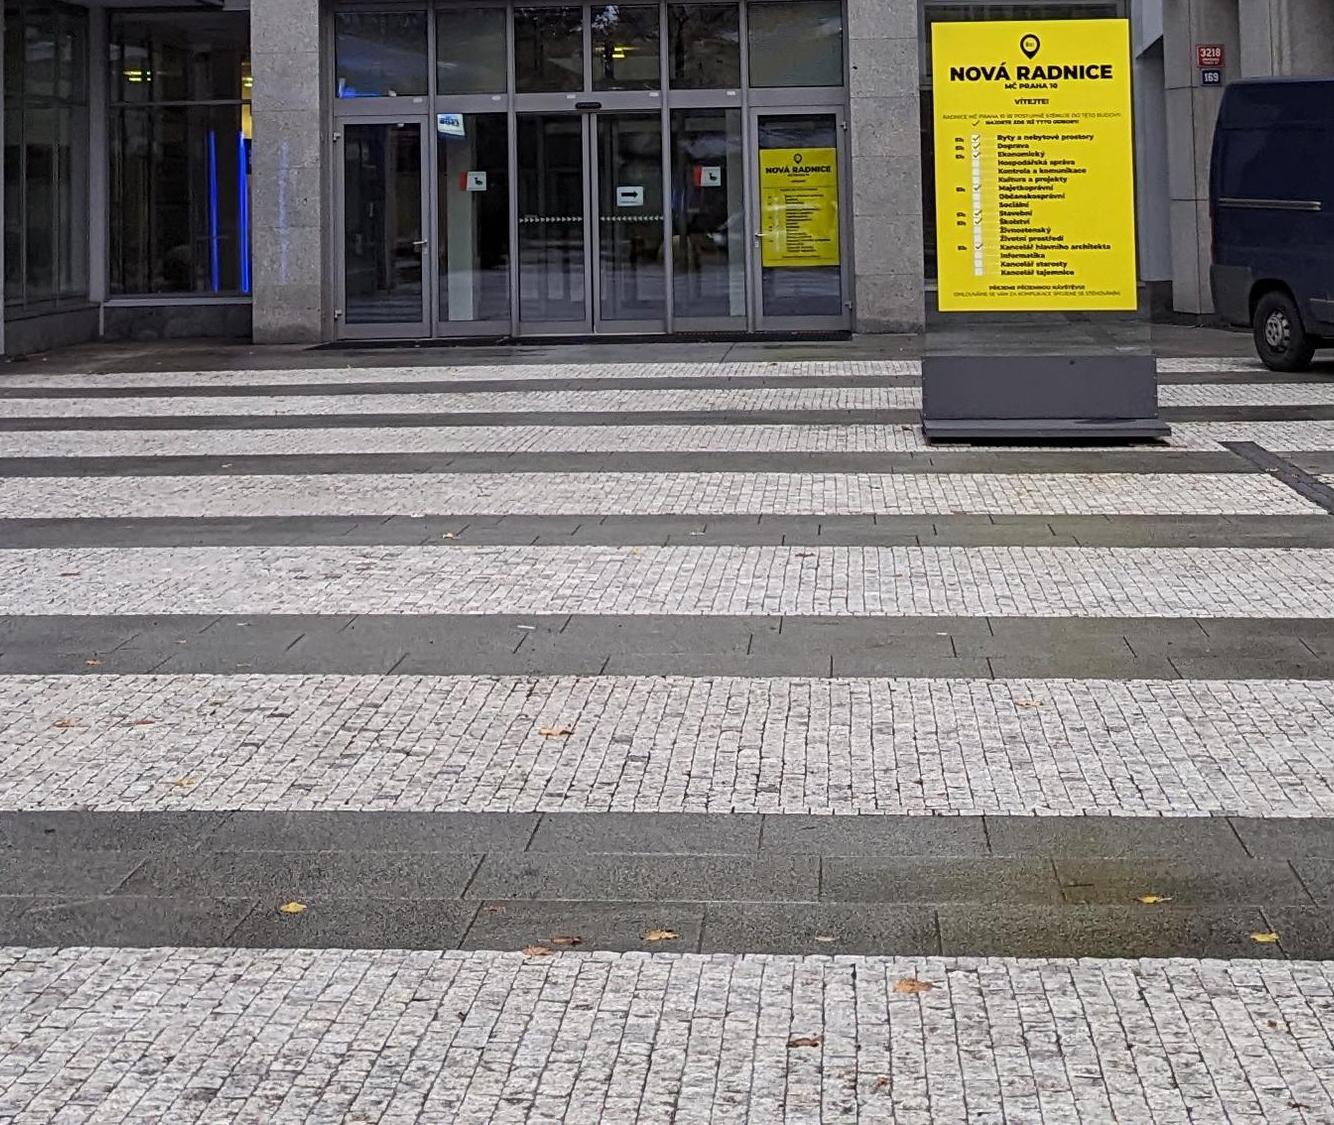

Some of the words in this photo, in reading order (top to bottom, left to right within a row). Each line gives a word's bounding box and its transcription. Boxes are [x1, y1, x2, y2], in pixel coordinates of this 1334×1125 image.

[1199, 47, 1221, 58] 3218
[950, 62, 1010, 81] NOVÁ
[1016, 65, 1113, 80] RADNICE
[1204, 72, 1219, 82] 169
[765, 165, 790, 174] NOVÁ
[792, 165, 831, 173] RADNICE
